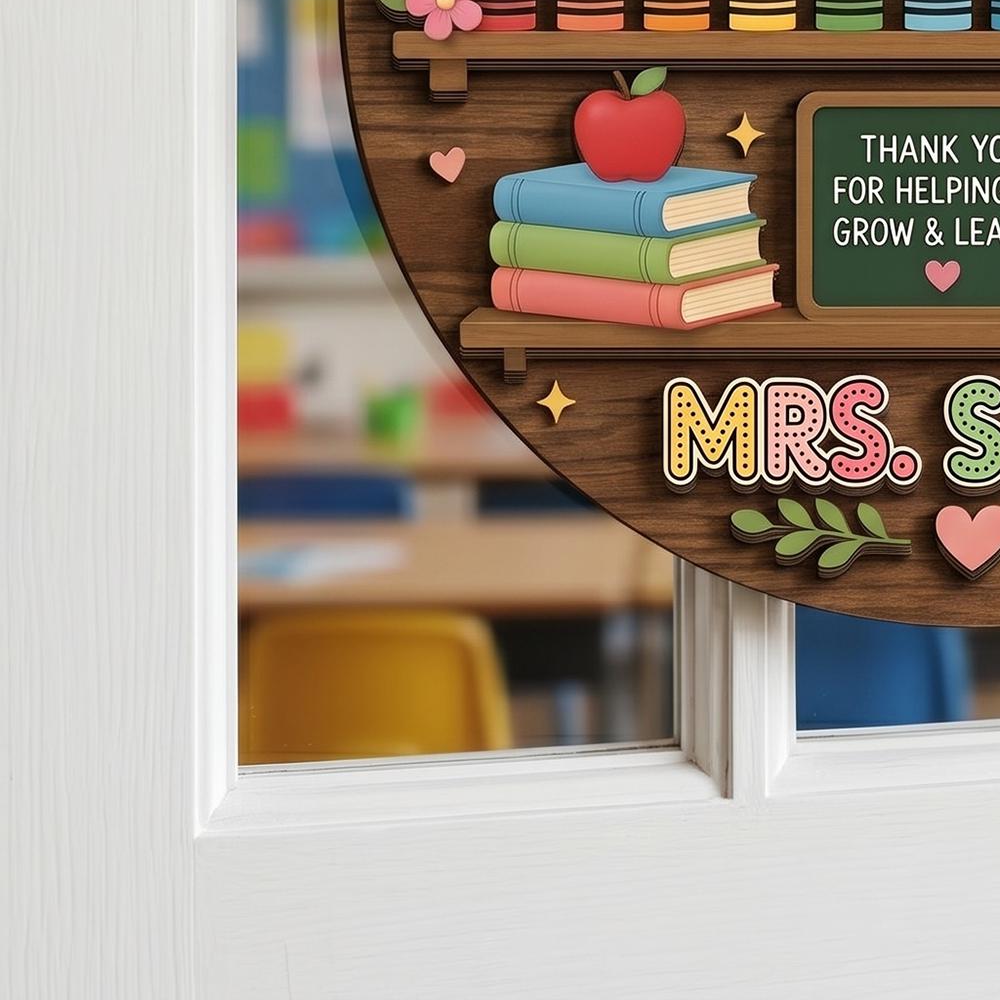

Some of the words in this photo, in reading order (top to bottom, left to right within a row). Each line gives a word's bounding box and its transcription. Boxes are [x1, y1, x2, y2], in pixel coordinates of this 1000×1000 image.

[860, 134, 959, 164] THANK
[833, 176, 884, 205] FOR
[833, 217, 914, 247] GROW
[924, 217, 944, 247] &
[663, 374, 922, 485] MRS.
